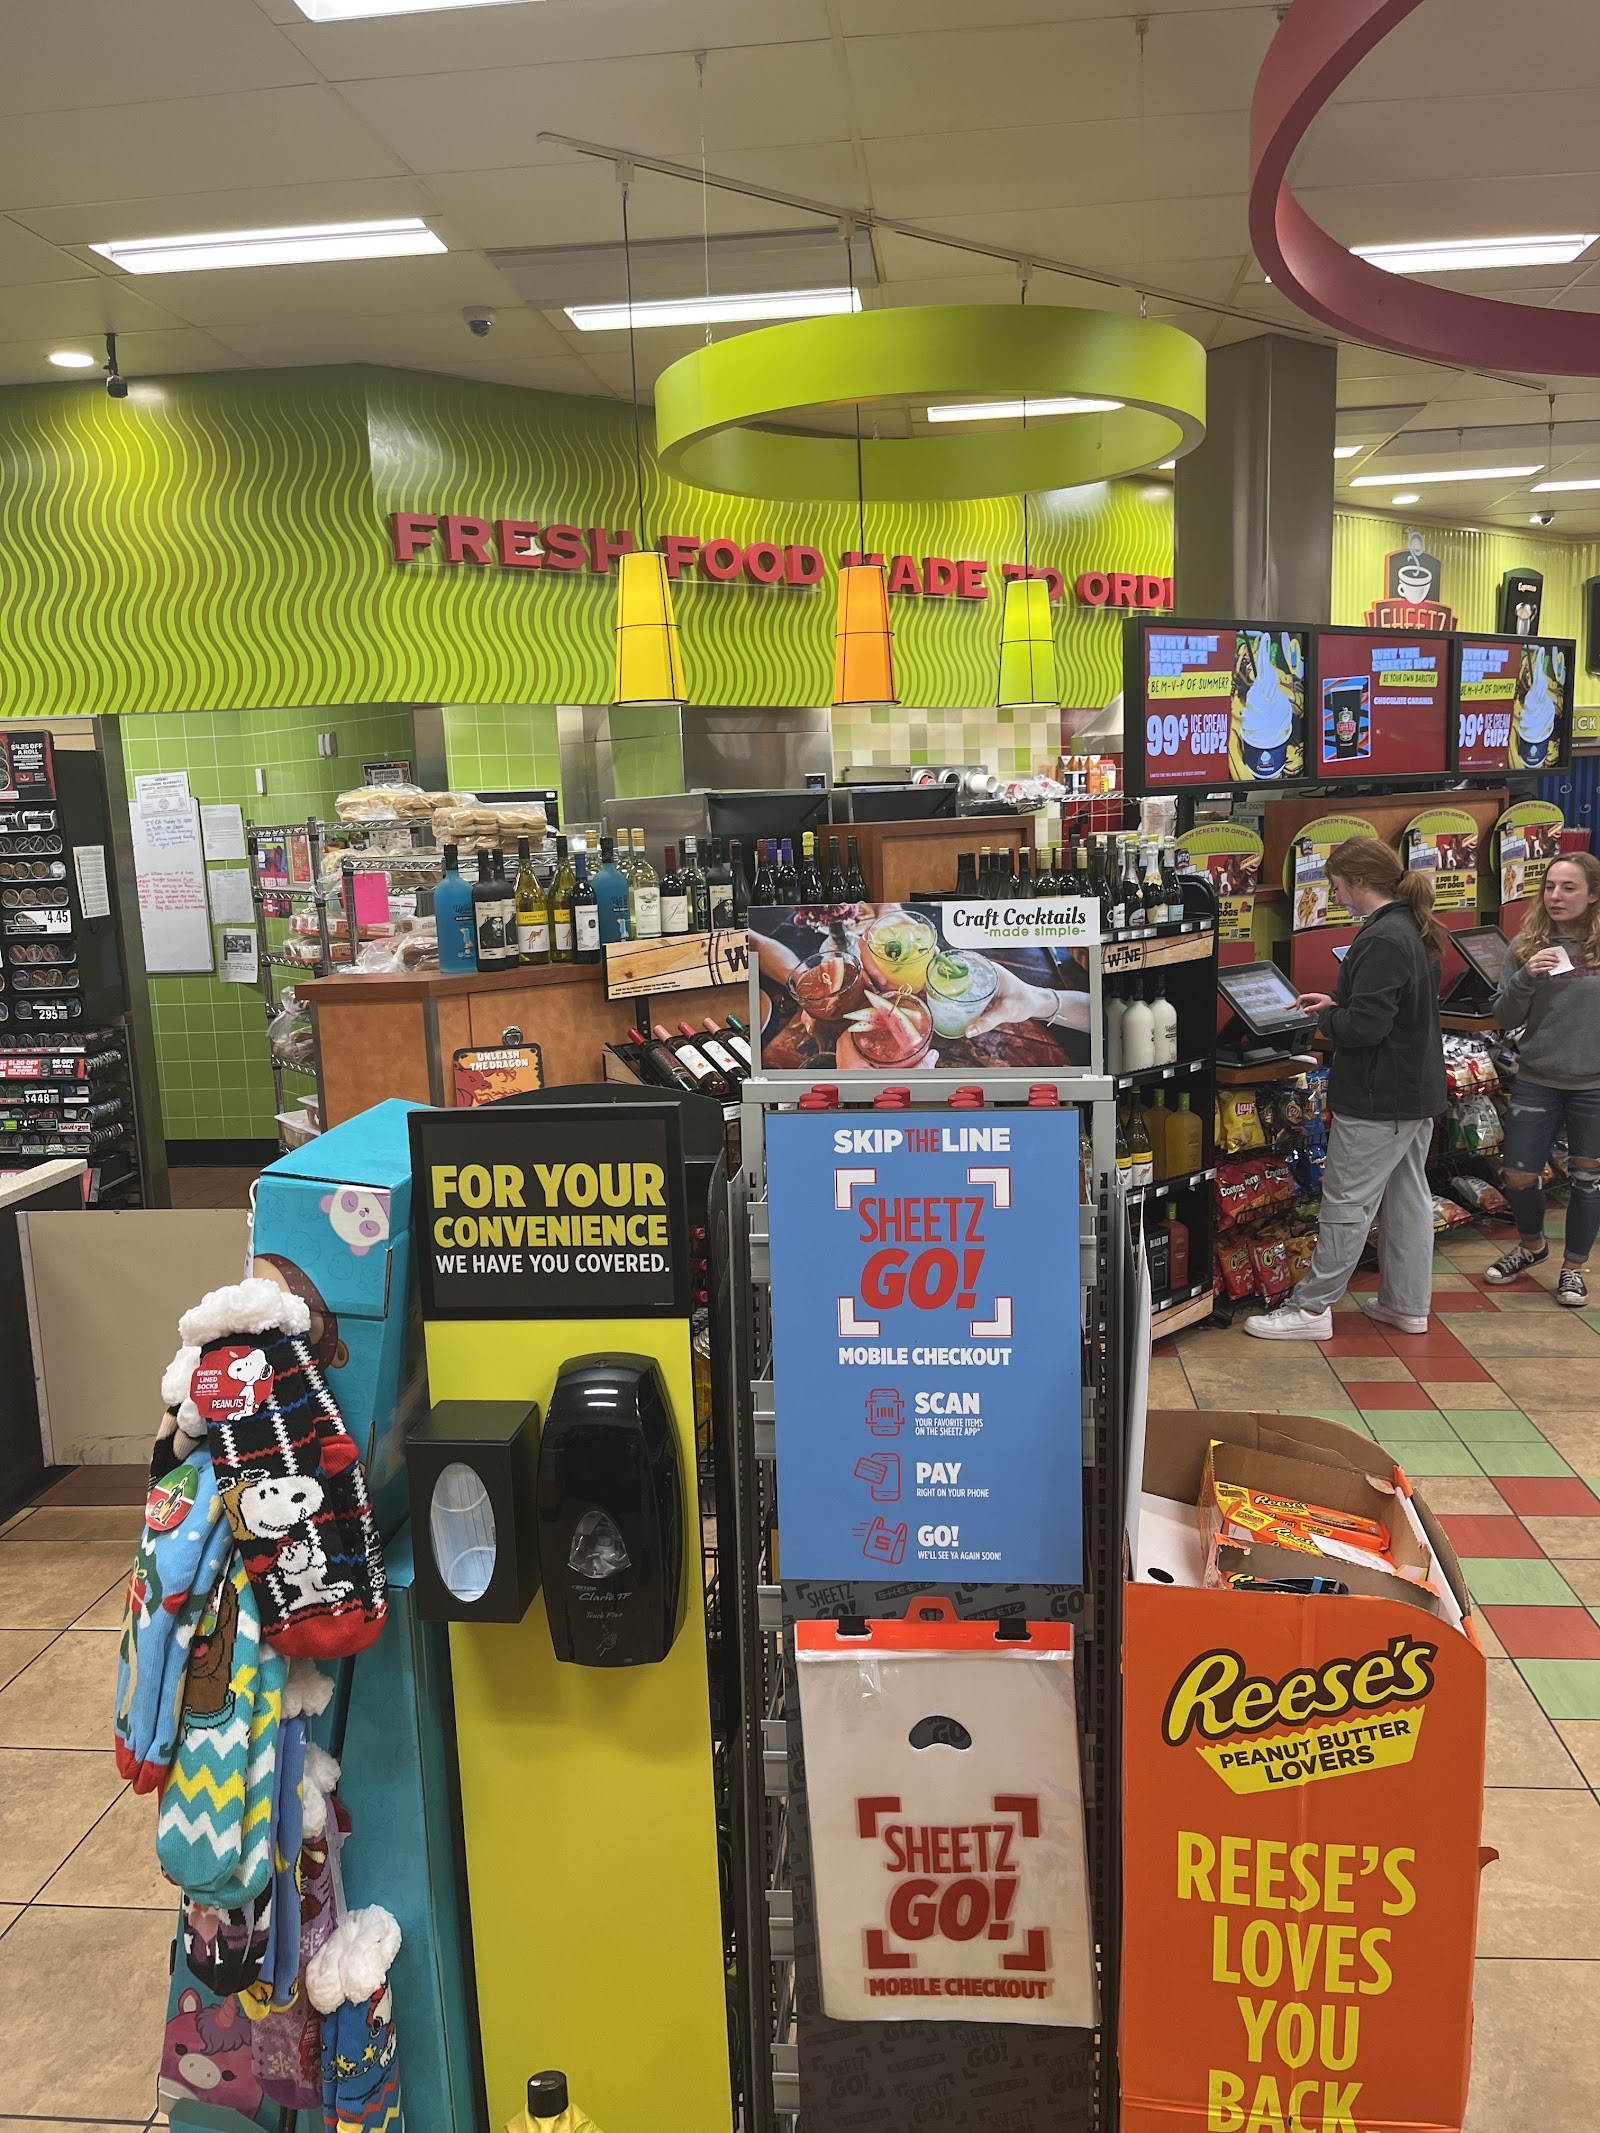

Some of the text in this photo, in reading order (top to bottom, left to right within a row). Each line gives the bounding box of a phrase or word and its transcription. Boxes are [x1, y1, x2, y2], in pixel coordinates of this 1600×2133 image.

[390, 511, 634, 574] FRESH
[661, 535, 826, 588] FOOD
[1077, 571, 1174, 609] ORD
[1149, 636, 1218, 652] WHY THE
[1149, 650, 1209, 666] SHEETZ
[1149, 663, 1184, 678] NOT
[1383, 674, 1390, 683] BE
[1151, 681, 1160, 693] BE
[1187, 679, 1198, 689] OF
[1198, 676, 1230, 689] SUMMER?
[1373, 696, 1434, 705] CHOCOLATE CARAMEL
[1191, 713, 1229, 733] ICE CREAM
[1572, 716, 1597, 731] ICK
[1191, 731, 1229, 756] CUPZ
[1483, 728, 1509, 748] CUPZ
[1249, 803, 1265, 812] pape
[1195, 827, 1220, 838] SCREEN
[1231, 828, 1255, 839] ORDER
[1317, 819, 1339, 828] SCREEN
[1349, 820, 1370, 830] ORDER
[1447, 880, 1465, 888] DOGS
[953, 906, 1086, 932] Craft Cocktails
[725, 945, 749, 973] W
[1107, 947, 1141, 968] WINE
[470, 1059, 529, 1071] THE DRAGON
[477, 1051, 520, 1062] UNLEASH
[833, 1128, 1011, 1154] SKIP THE LINE
[431, 1162, 666, 1209] FOR YOUR
[1220, 1182, 1245, 1198] Doritos
[433, 1214, 670, 1248] CONVENIENCE
[858, 1197, 985, 1244] SHEETZ
[435, 1252, 671, 1273] WE HAVE YOU COVERED.
[860, 1247, 986, 1311] GO!
[838, 1347, 1013, 1366] MOBILE CHECKOUT
[211, 1399, 243, 1409] PEANUTS
[914, 1391, 980, 1415] SCAN
[915, 1418, 984, 1428] YOUR FAVORITE ITEMS
[915, 1427, 963, 1436] ON THE SHEETZ
[916, 1461, 962, 1485] PAY
[916, 1488, 990, 1498] RIGHT ON YOUR PHONE
[1254, 1495, 1309, 1510] Reese's
[917, 1525, 959, 1548] GO!
[917, 1550, 1003, 1561] WE'LL SEE YA AGAIN SOON!
[807, 1583, 855, 1609] SHEETZ
[1163, 1636, 1436, 1746] Reese's
[1219, 1719, 1411, 1769] PEANUT BUTTER
[1264, 1745, 1376, 1783] LOVERS
[884, 1824, 1020, 1874] SHEETZ
[1177, 1830, 1417, 1917] REESE'S
[886, 1878, 1022, 1942] GO!
[1212, 1914, 1394, 1996] LOVES
[866, 1977, 1050, 2000] MOBILE CHECKOUT
[1236, 1995, 1361, 2072] YOU
[1207, 2068, 1384, 2133] BACK
